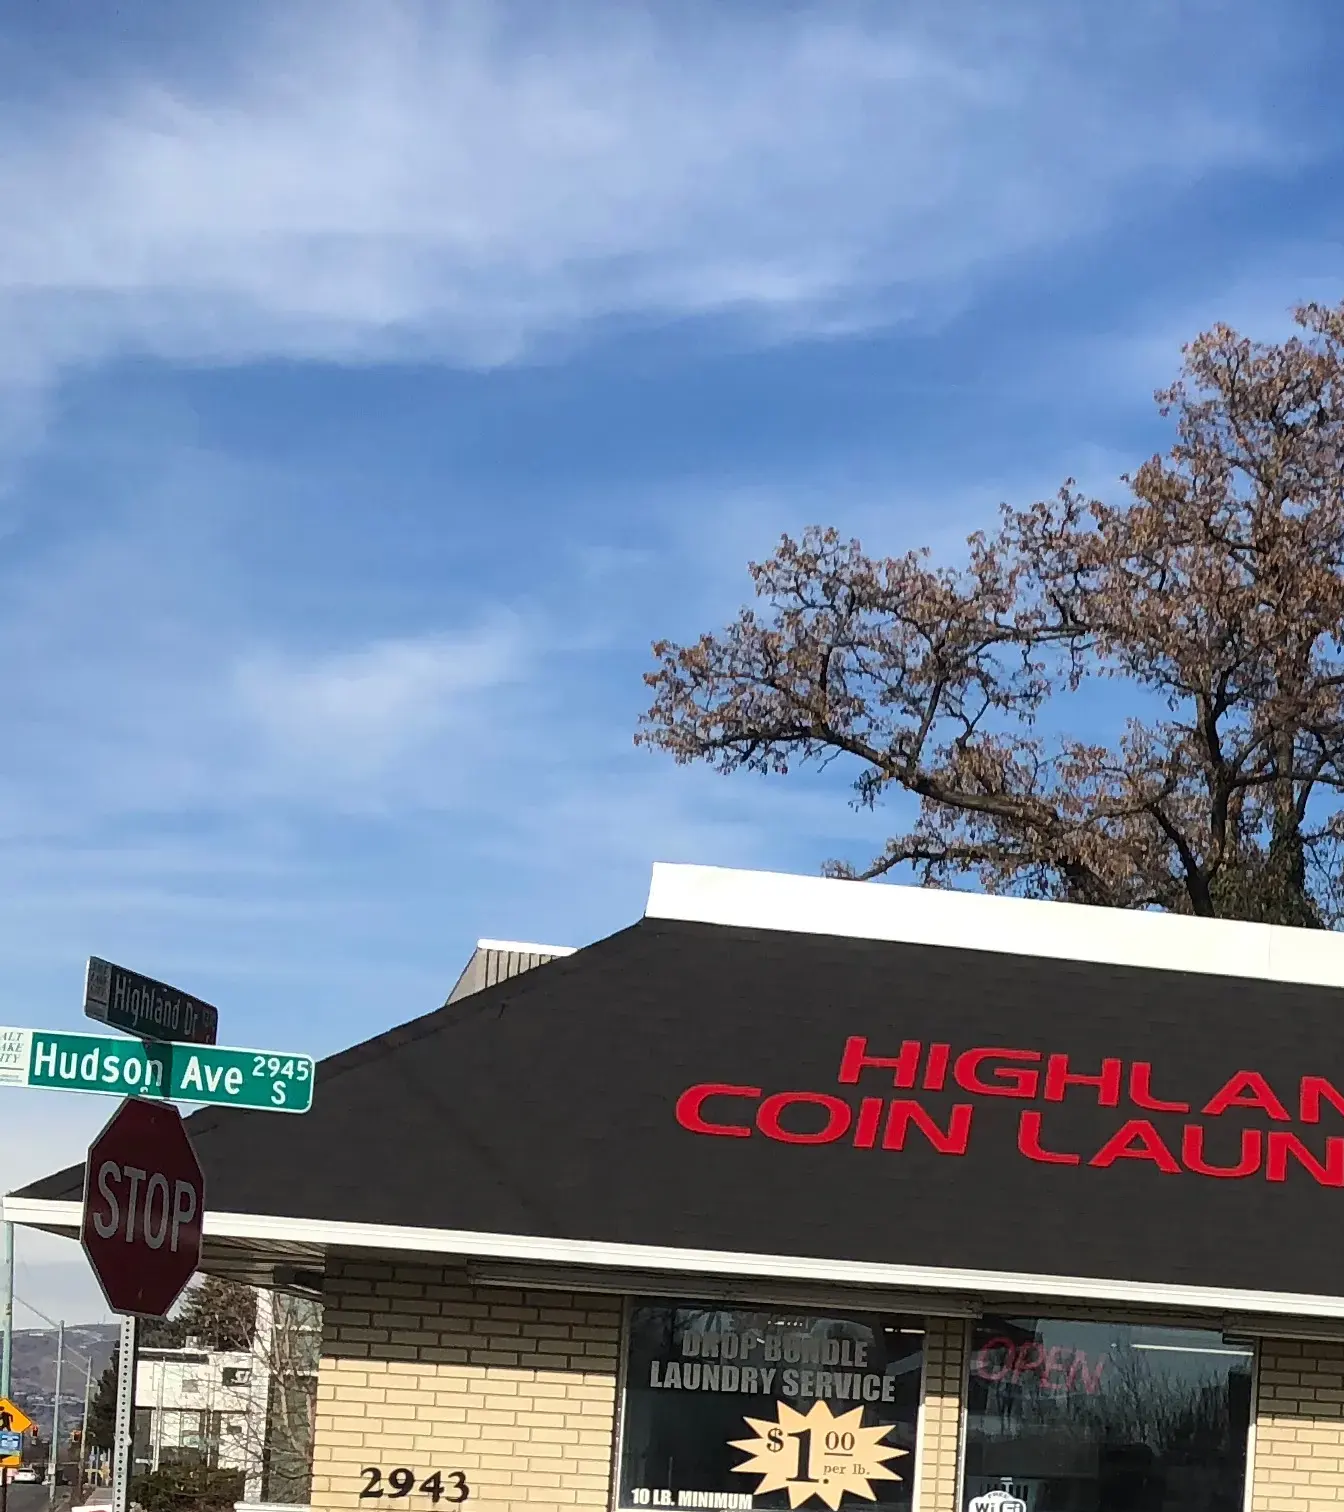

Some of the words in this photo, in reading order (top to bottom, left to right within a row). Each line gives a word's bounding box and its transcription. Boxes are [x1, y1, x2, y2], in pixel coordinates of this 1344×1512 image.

[113, 973, 181, 1028] Highland
[184, 1000, 199, 1040] Dr
[0, 1031, 24, 1041] ALT
[0, 1042, 24, 1052] AKE
[0, 1053, 20, 1063] ITY
[34, 1041, 163, 1087] Hudson
[180, 1055, 244, 1095] Ave
[252, 1055, 309, 1081] 2945
[270, 1080, 287, 1105] S
[675, 1083, 974, 1157] COIN
[93, 1160, 197, 1253] STOP
[682, 1329, 758, 1361] DROP
[764, 1334, 868, 1368] BUNDLE
[976, 1336, 1107, 1394] OPEN
[650, 1360, 776, 1395] LAUNDRY
[782, 1367, 896, 1402] SERVICE
[359, 1467, 470, 1503] 2943
[823, 1464, 846, 1476] per
[852, 1463, 870, 1475] lb.
[631, 1487, 651, 1505] 10
[653, 1489, 675, 1506] LB.
[678, 1489, 753, 1510] MINIMUM
